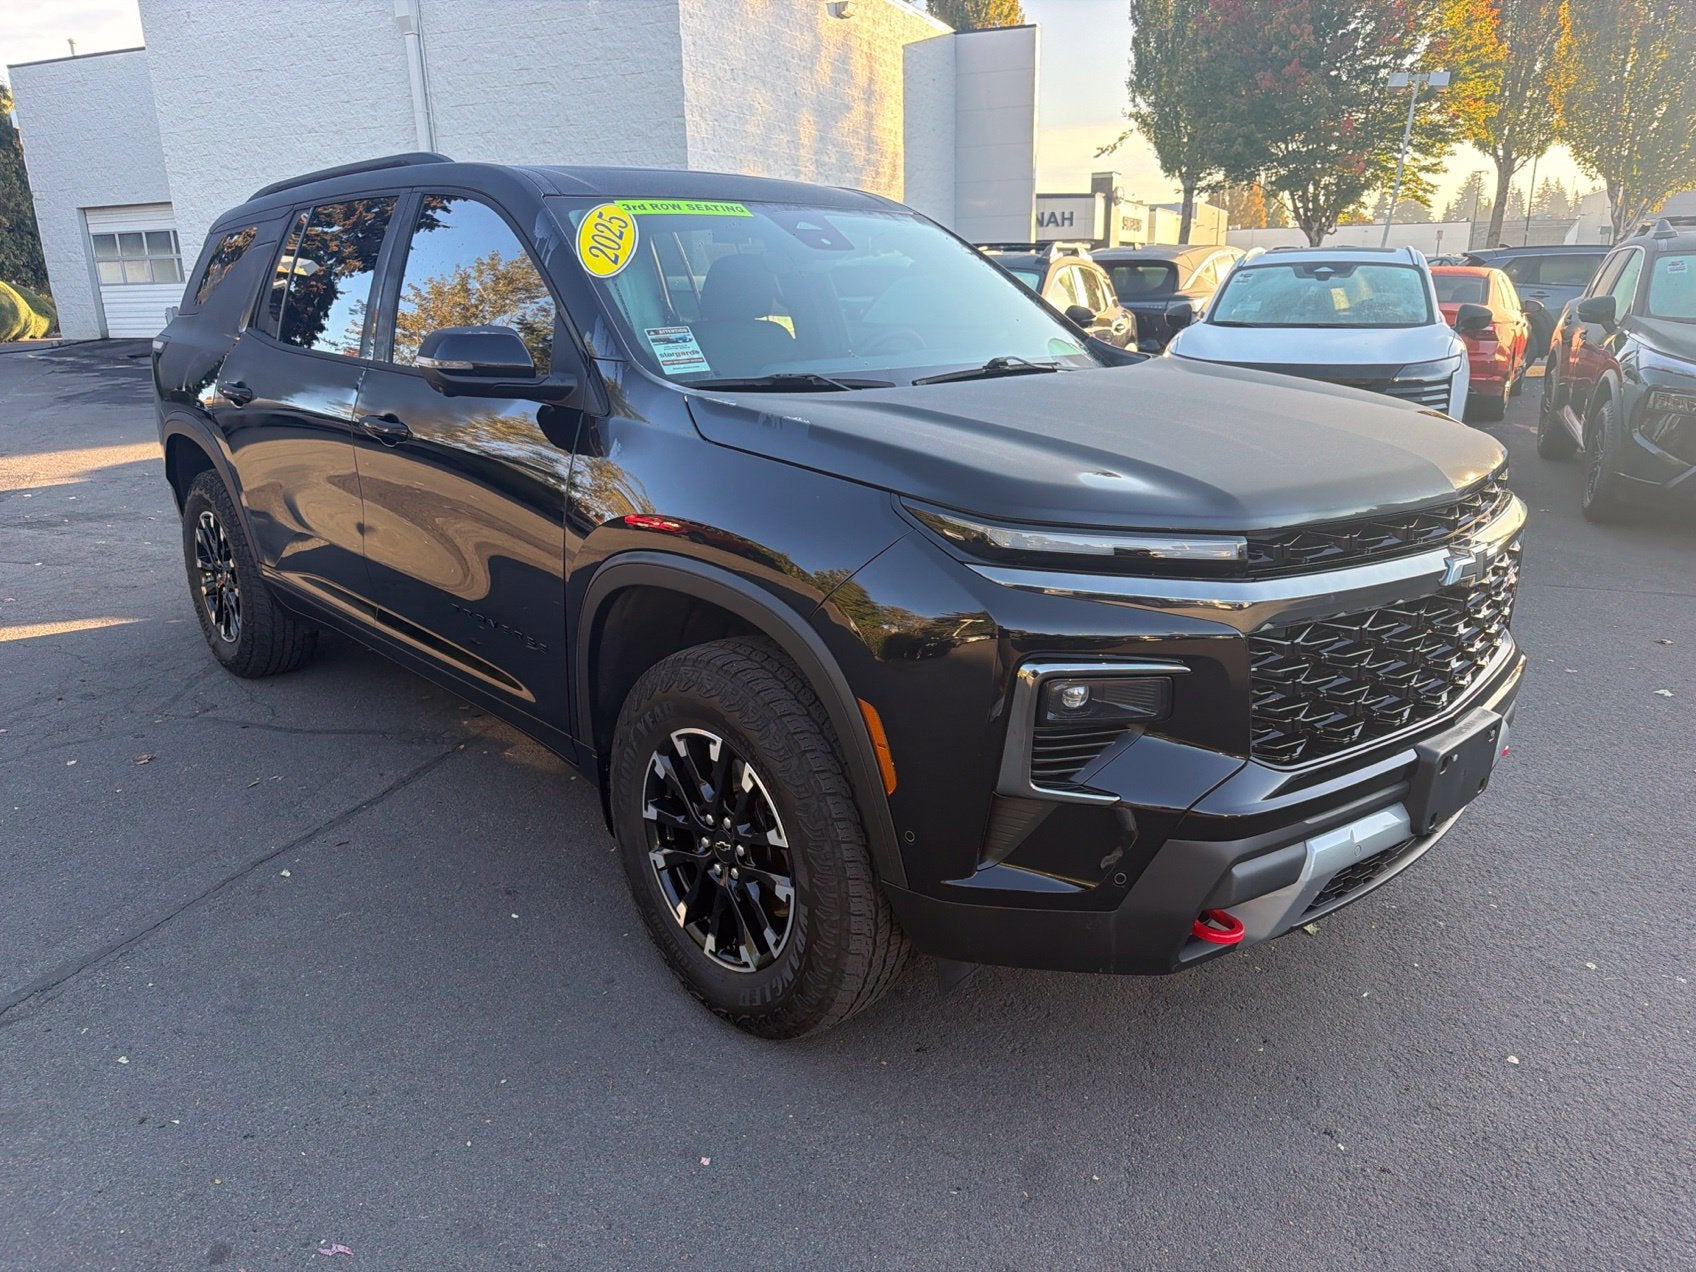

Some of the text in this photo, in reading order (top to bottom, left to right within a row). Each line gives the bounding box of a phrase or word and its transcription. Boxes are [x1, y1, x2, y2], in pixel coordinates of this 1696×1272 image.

[622, 203, 746, 214] 3rd ROW SEATING
[588, 211, 629, 266] 2025
[738, 903, 809, 1007] WRANGLER
